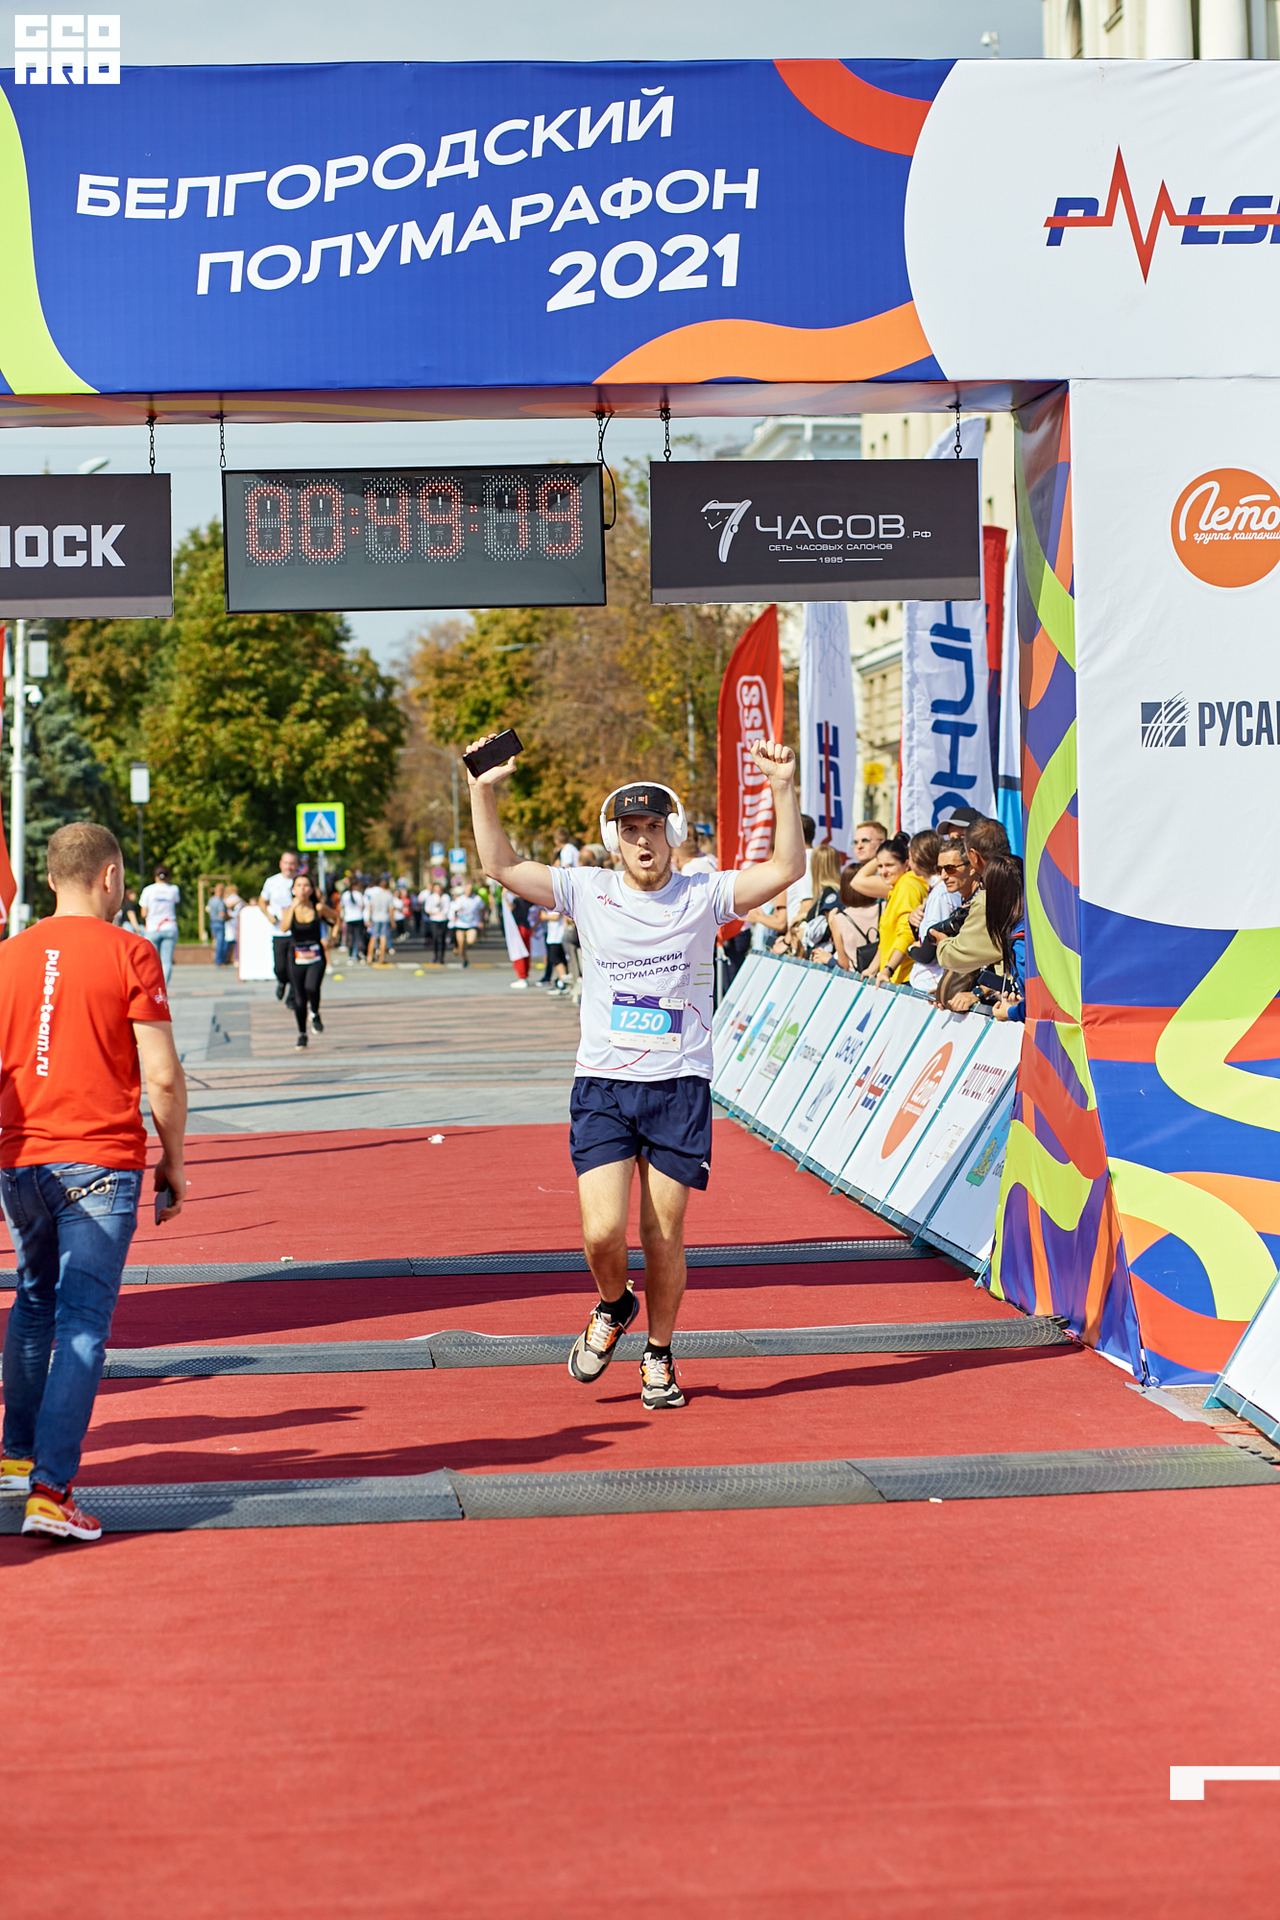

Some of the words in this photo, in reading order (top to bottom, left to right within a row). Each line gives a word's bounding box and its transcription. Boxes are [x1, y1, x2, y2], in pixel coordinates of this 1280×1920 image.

[76, 86, 674, 219] БЕЛГОРОДСКИЙ
[197, 168, 760, 295] ПОЛУМАРАФОН
[546, 233, 741, 312] 2021
[768, 544, 793, 552] СЕТЬ
[796, 543, 844, 551] ЧАСОВЫХ
[846, 543, 893, 551] САЛОНОВ
[1193, 532, 1231, 545] группа
[818, 556, 843, 564] 1995
[1198, 700, 1280, 747] РУСА
[609, 962, 691, 982] ПОЛУМАРАФОН
[36, 949, 60, 1077] pulse-team.ru
[619, 1010, 665, 1032] 1250
